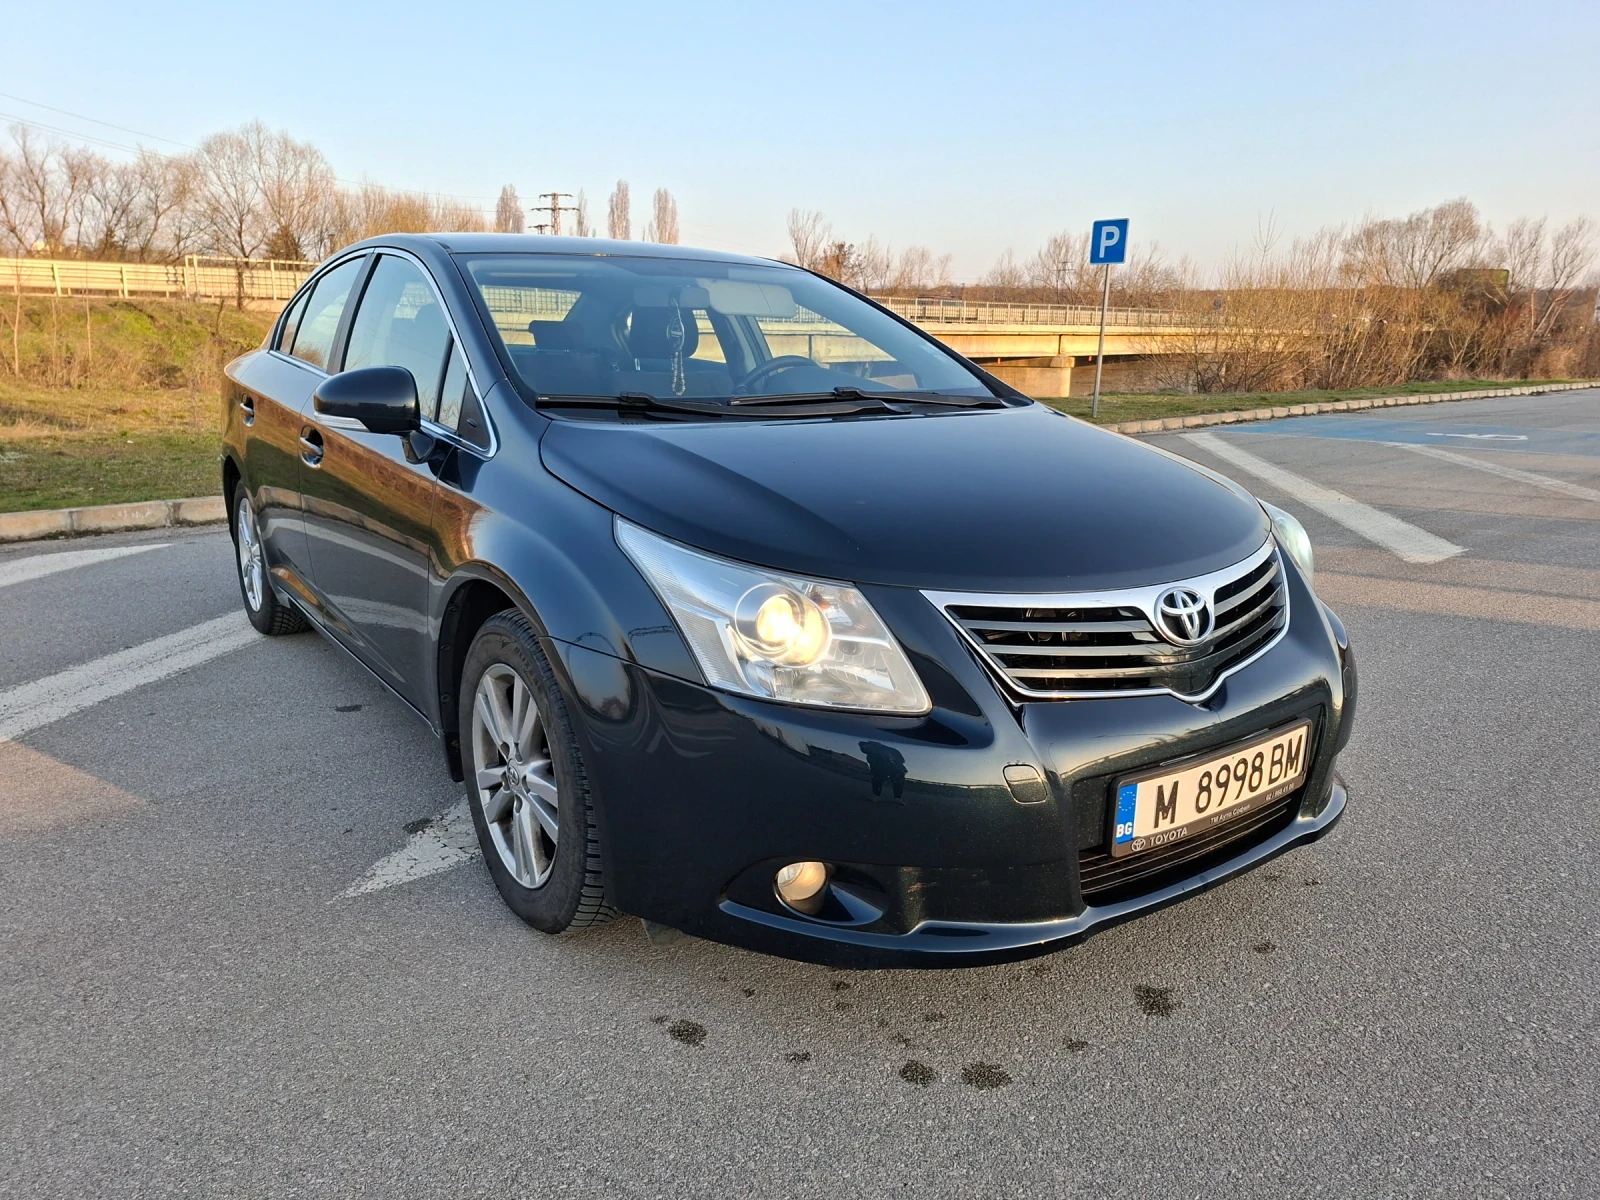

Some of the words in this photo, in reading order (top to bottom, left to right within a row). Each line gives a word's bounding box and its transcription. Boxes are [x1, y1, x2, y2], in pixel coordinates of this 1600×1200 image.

[1099, 226, 1120, 258] P
[1153, 780, 1179, 829] M
[1195, 751, 1264, 814] 8998
[1268, 734, 1303, 785] BM
[1116, 822, 1133, 838] BG
[1150, 827, 1188, 846] TOYOTA
